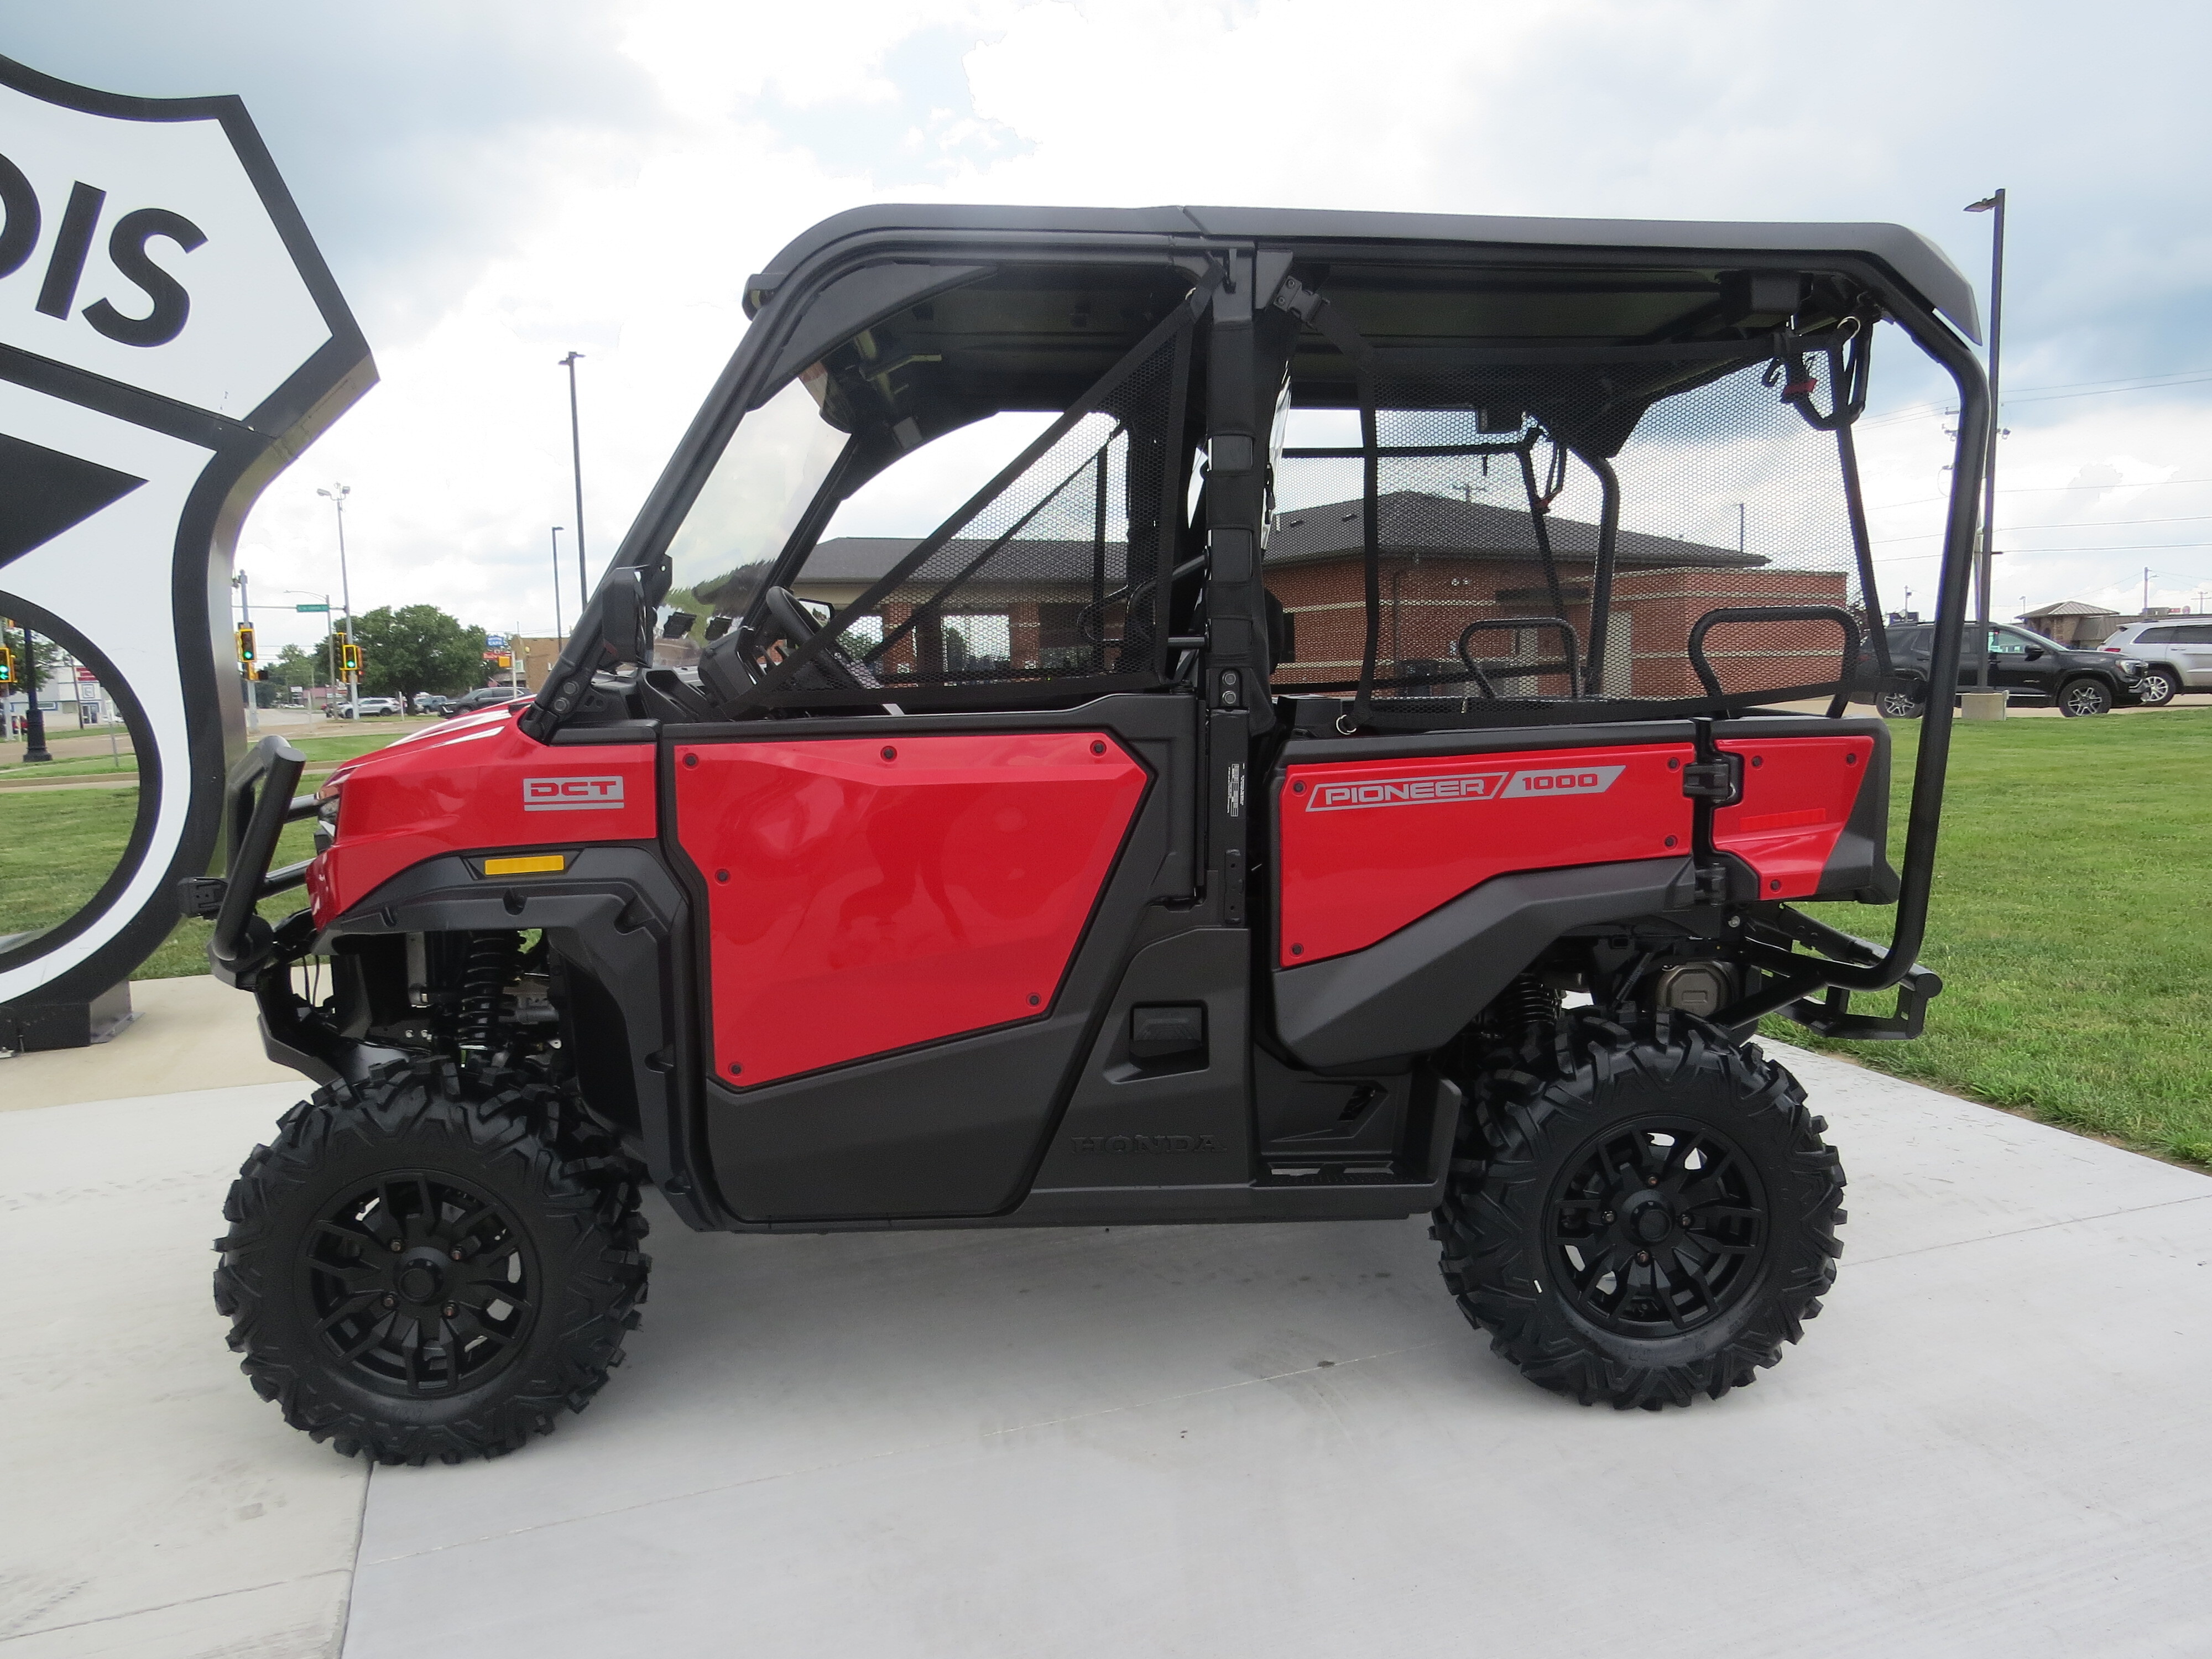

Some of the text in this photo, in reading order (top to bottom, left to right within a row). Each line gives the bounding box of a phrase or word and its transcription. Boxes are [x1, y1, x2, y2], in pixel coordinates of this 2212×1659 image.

[531, 781, 616, 797] DCT
[1325, 773, 1598, 805] PIONEER 1000
[1071, 1134, 1227, 1154] HONDA
